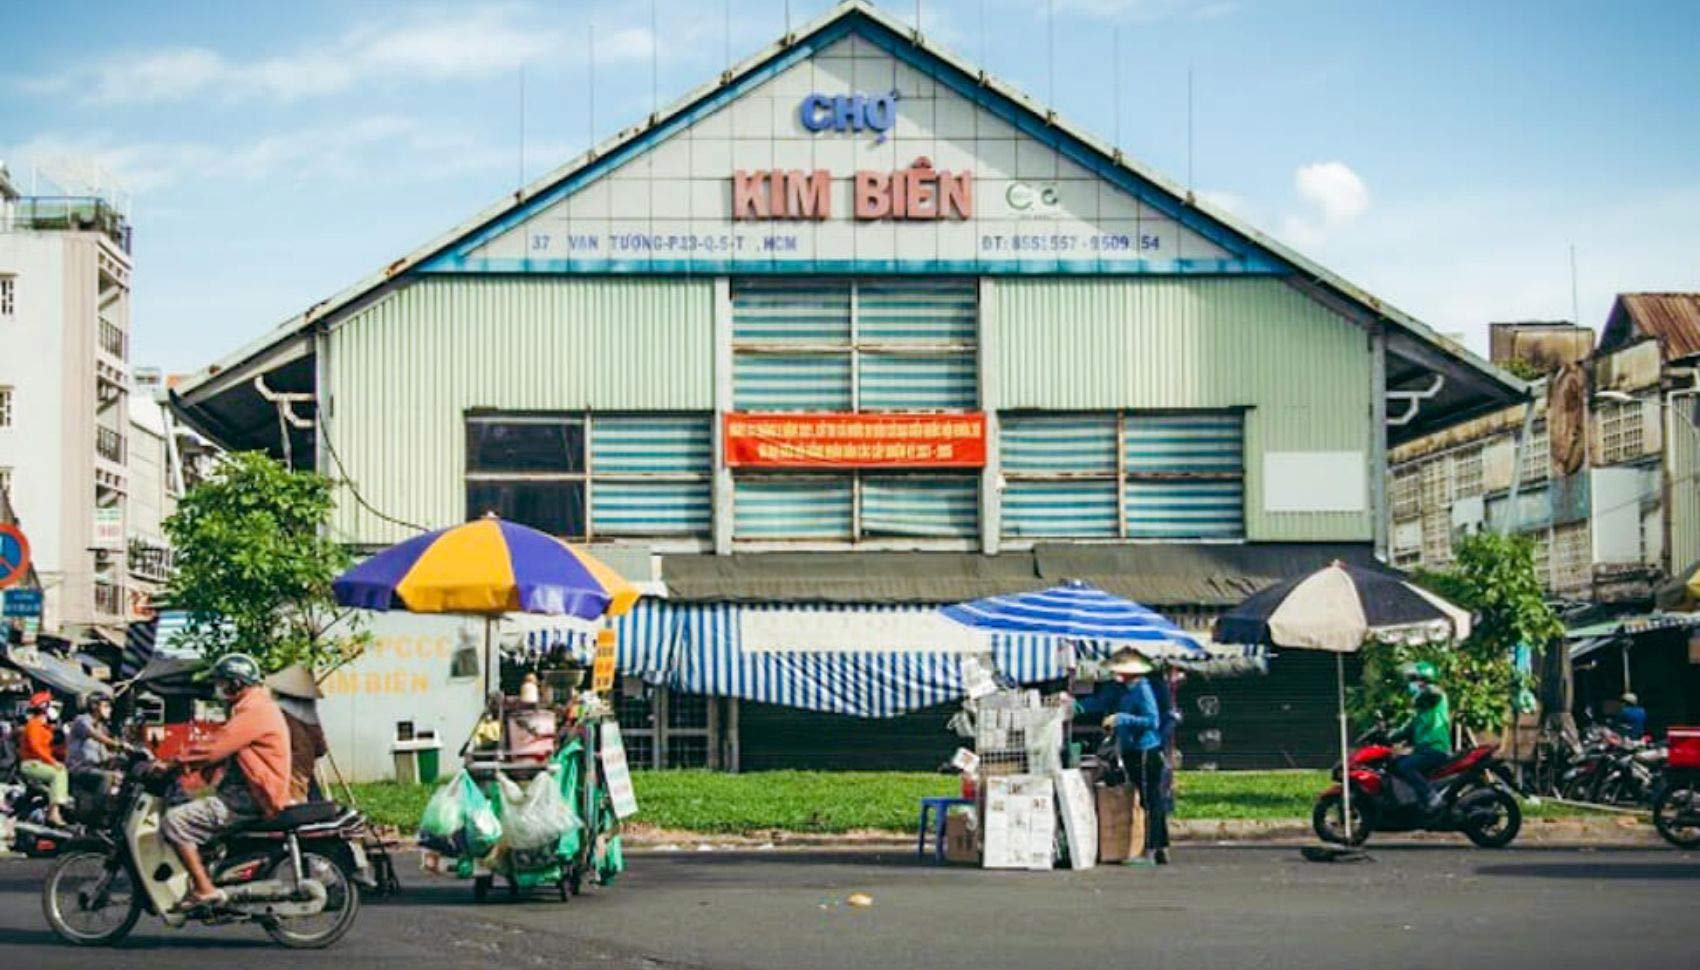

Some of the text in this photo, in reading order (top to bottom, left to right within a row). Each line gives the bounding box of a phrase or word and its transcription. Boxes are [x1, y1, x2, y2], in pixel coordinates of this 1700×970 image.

[801, 89, 897, 144] CHỢ
[732, 156, 972, 221] KIM BIÊN
[532, 235, 549, 250] 37
